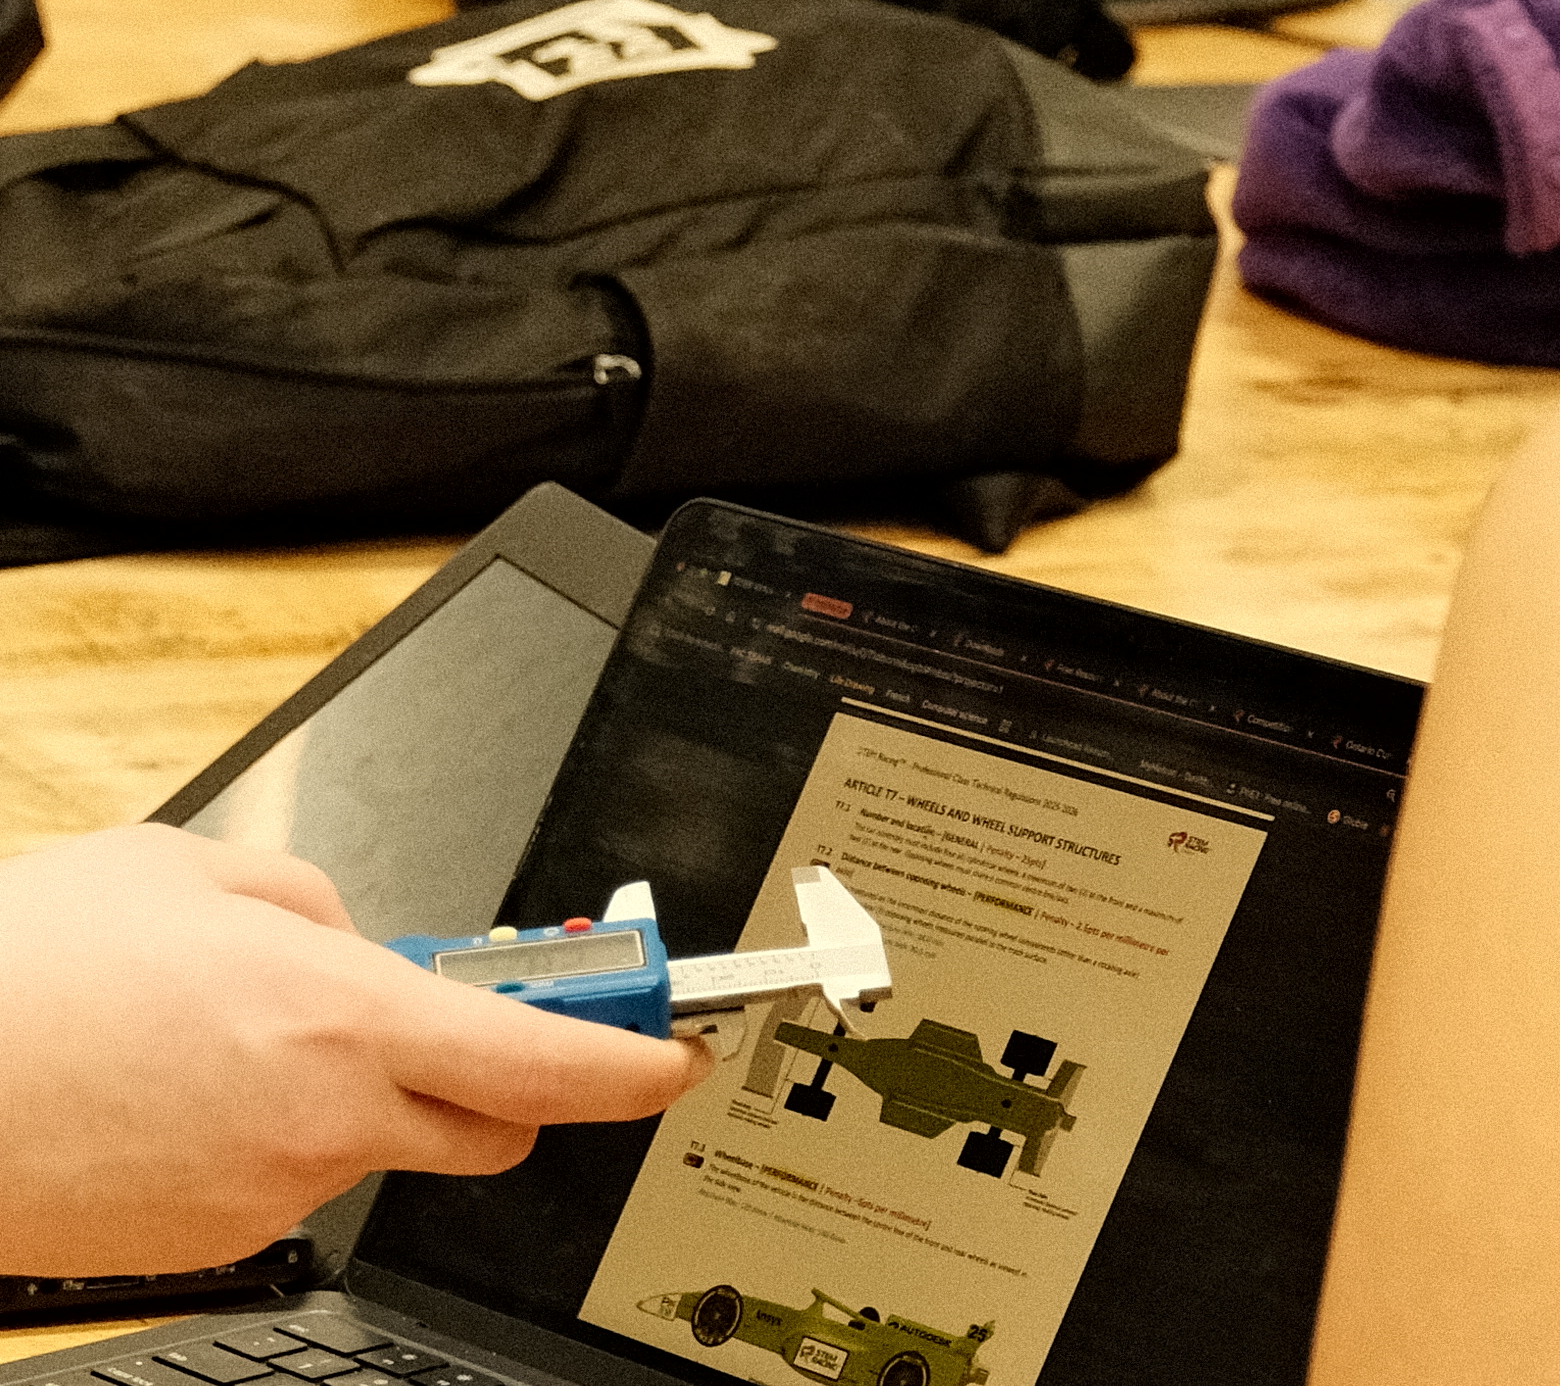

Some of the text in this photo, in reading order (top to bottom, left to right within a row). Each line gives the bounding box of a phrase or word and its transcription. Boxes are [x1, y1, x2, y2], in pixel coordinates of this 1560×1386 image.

[843, 779, 883, 796] ARTICLE
[883, 789, 898, 800] T7
[905, 797, 946, 815] WHEELS
[947, 808, 971, 821] AND
[971, 815, 1007, 831] WHEEL
[1007, 826, 1055, 845] SUPPORT
[1055, 839, 1121, 865] STRUCTURES
[859, 809, 890, 821] Number
[890, 818, 905, 826] and
[841, 853, 872, 867] Distance
[899, 1325, 951, 1347] AUTODESK
[967, 1326, 989, 1342] 25
[815, 1350, 838, 1360] STEM
